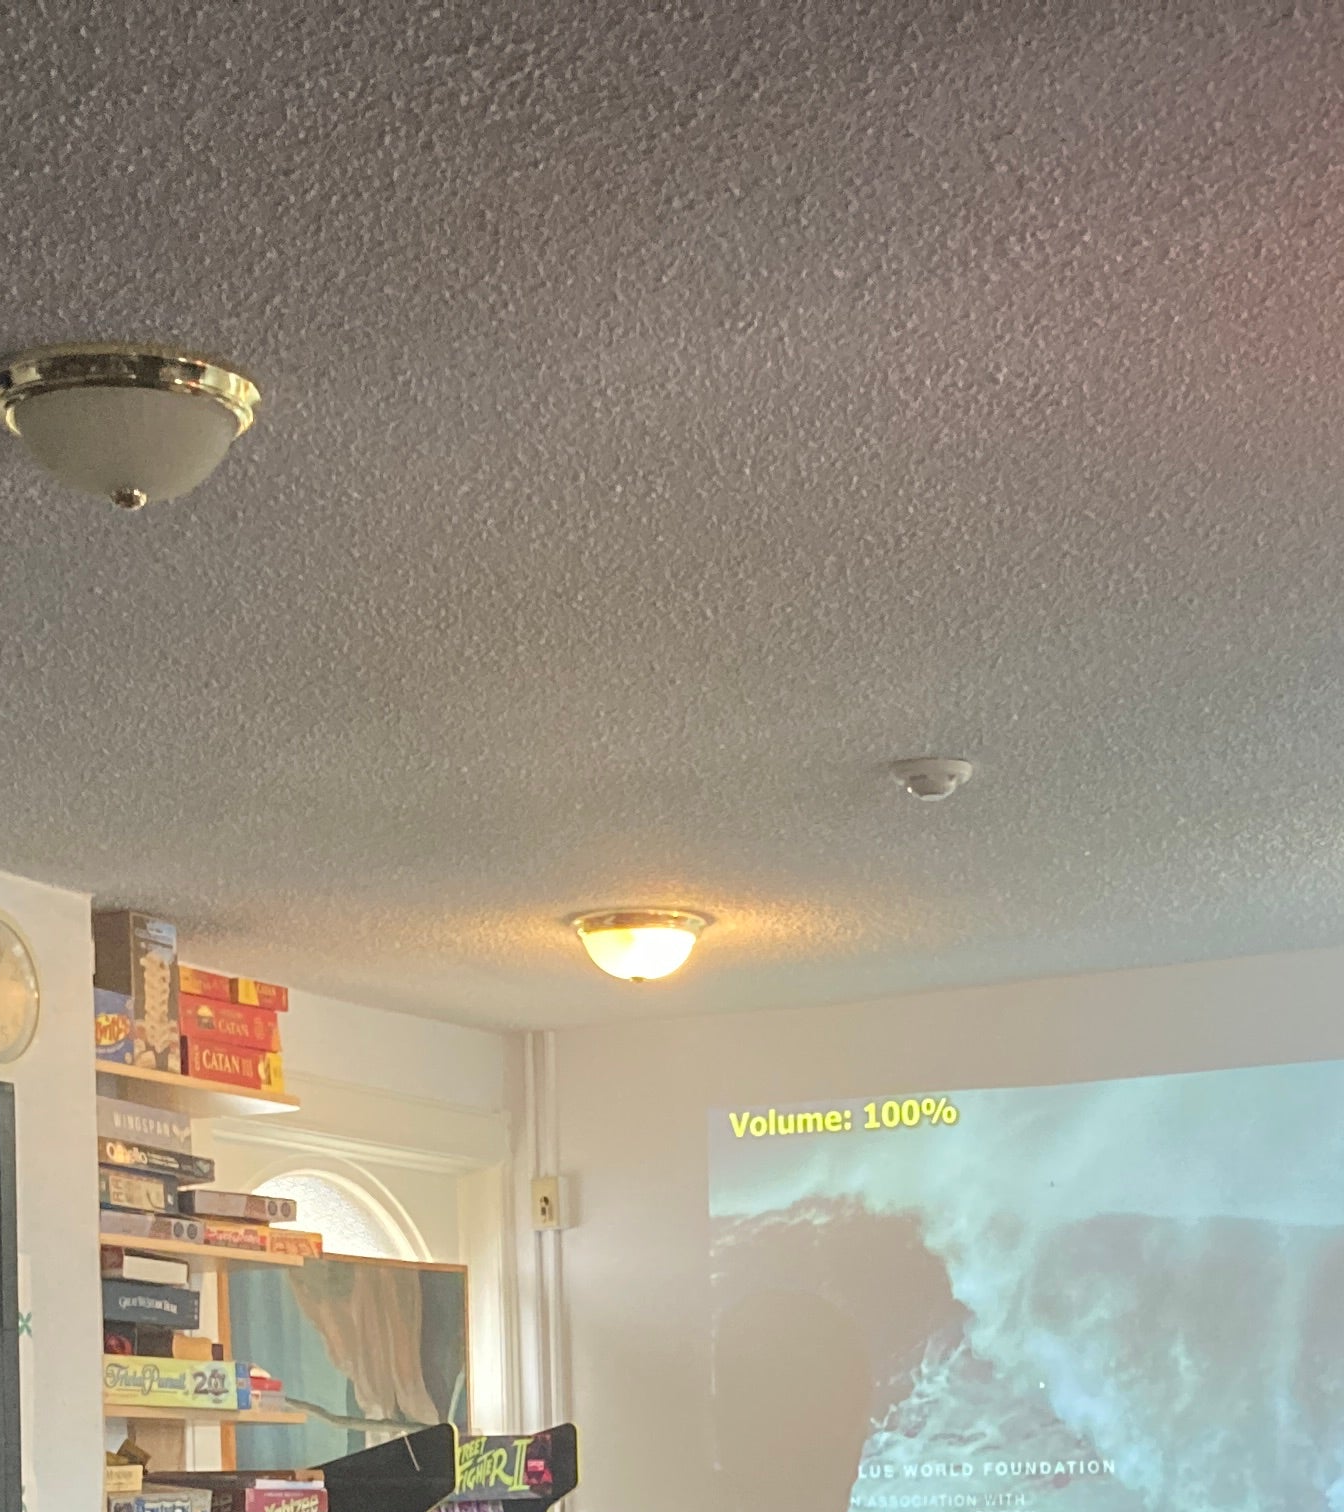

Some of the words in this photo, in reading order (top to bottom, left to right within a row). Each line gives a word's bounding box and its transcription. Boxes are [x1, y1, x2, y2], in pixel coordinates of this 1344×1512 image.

[218, 1020, 249, 1037] CATAN
[202, 1050, 240, 1074] CATAN
[113, 1112, 171, 1137] WINGSPAN
[729, 1109, 852, 1138] Volume:
[863, 1098, 957, 1129] 100%
[456, 1448, 514, 1494] FIGHTER
[858, 1464, 895, 1479] LUE
[903, 1463, 973, 1478] WORLD
[983, 1460, 1116, 1476] FOUNDATION
[984, 1493, 1026, 1507] WITH
